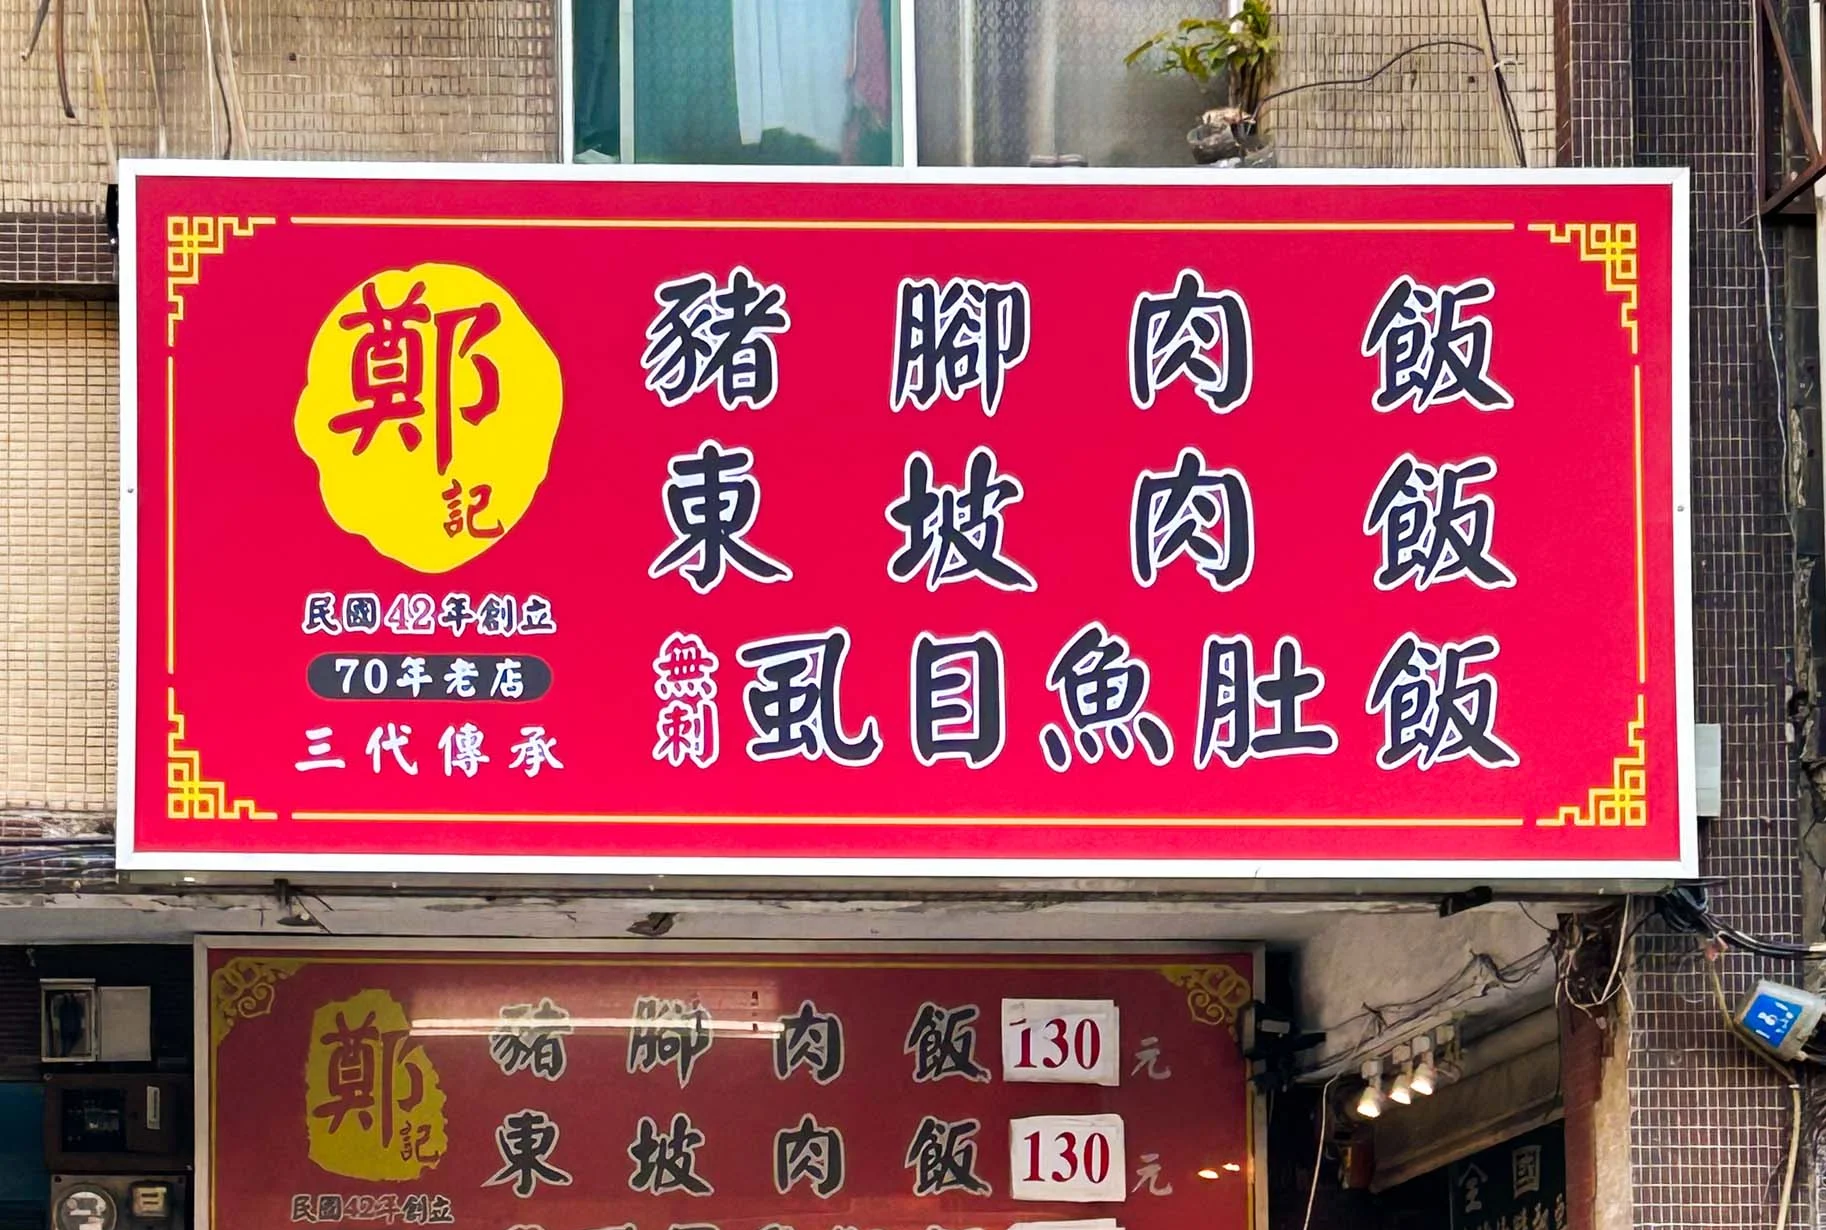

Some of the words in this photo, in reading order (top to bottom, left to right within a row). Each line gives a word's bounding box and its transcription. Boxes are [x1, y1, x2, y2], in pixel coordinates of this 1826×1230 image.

[640, 265, 1515, 416] 豬腳肉飯
[328, 281, 504, 540] 鄭記
[648, 438, 1518, 594] 東坡肉飯
[302, 592, 557, 636] 民國42年創立
[334, 657, 527, 700] 70年老店
[651, 631, 719, 770] 無刺
[736, 619, 1520, 773] 虱目魚肚飯
[294, 722, 564, 778] 三代傳承
[312, 1010, 442, 1165] 鄭記
[488, 996, 992, 1088] 豬腳肉飯
[1012, 1017, 1101, 1070] 130
[1130, 1036, 1172, 1080] 元
[291, 1193, 455, 1225] 民國42年創立
[480, 1112, 992, 1198] 東坡肉飯
[1022, 1131, 1110, 1184] 130
[1132, 1153, 1173, 1197] 元
